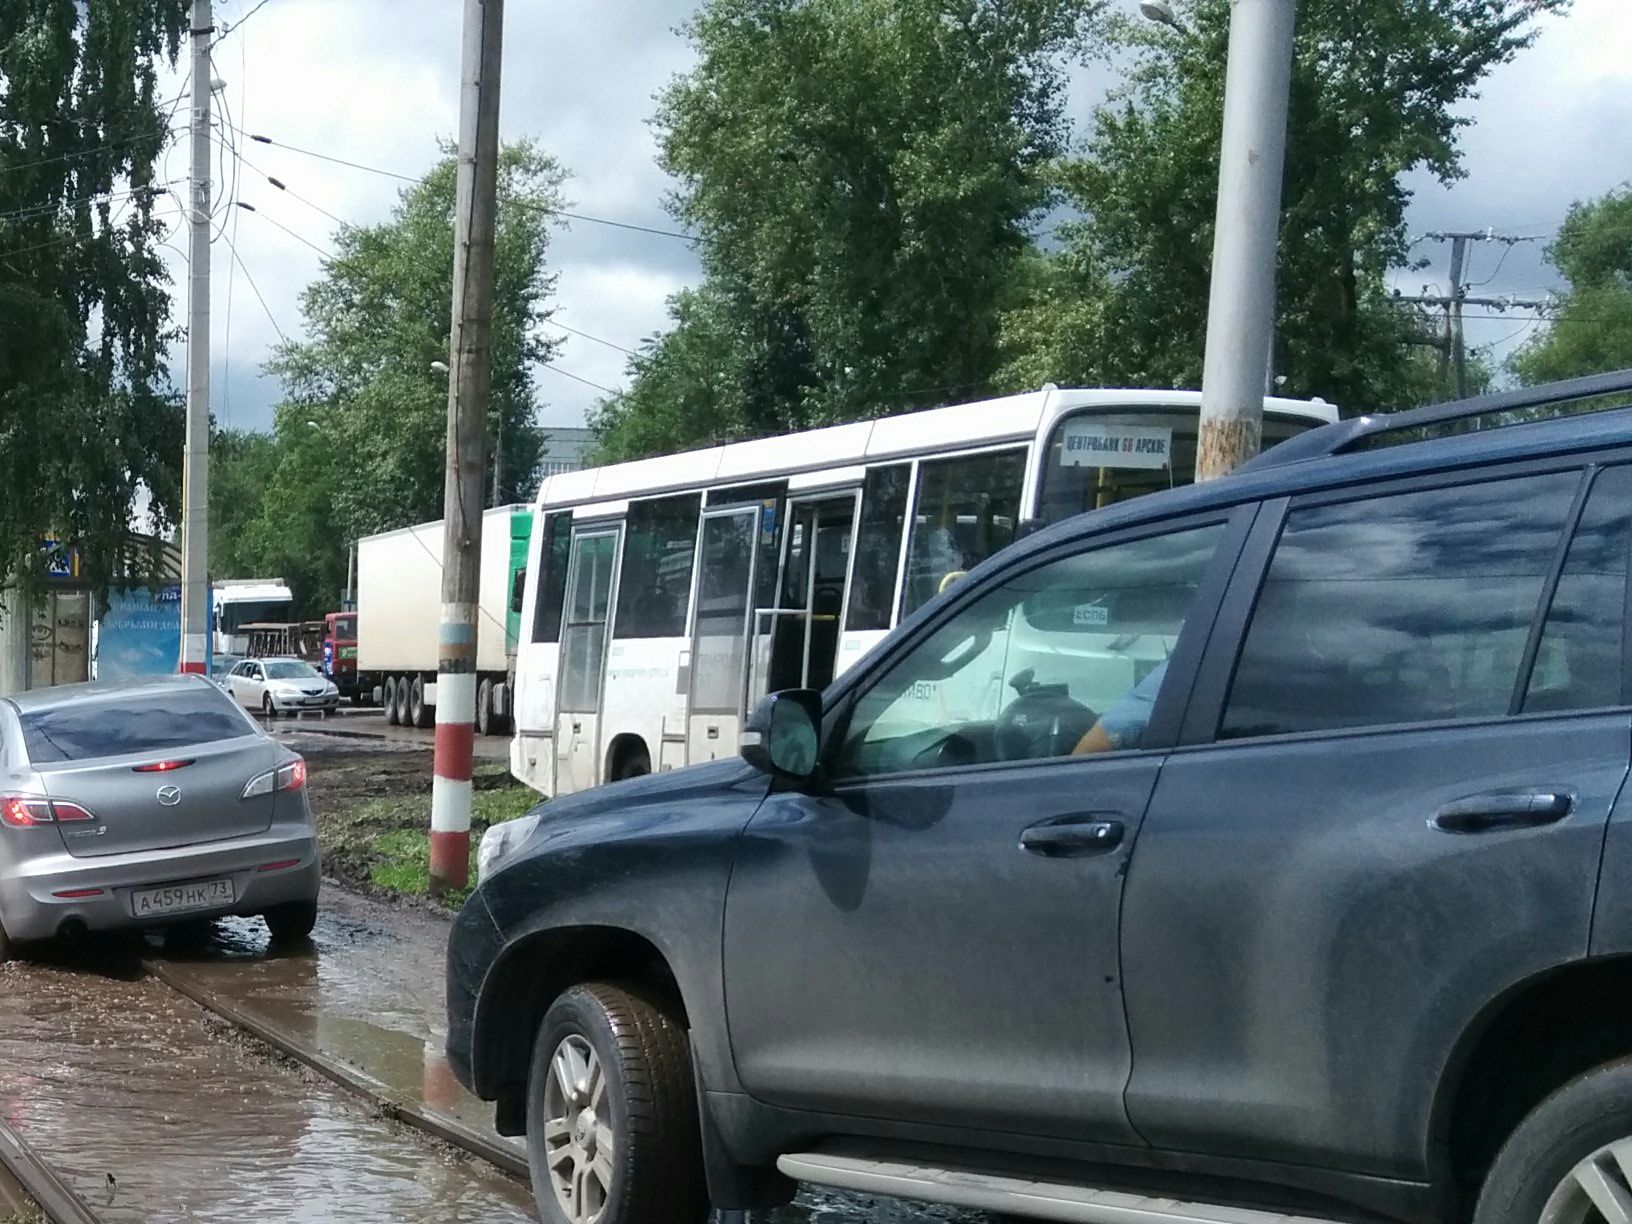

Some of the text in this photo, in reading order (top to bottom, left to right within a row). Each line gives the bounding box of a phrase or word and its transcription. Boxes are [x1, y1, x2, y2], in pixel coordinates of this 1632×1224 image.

[1066, 435, 1120, 452] ЦЕНТРОБАНК
[1135, 438, 1166, 454] АРСКОЕ
[140, 881, 228, 910] А459НК 73
